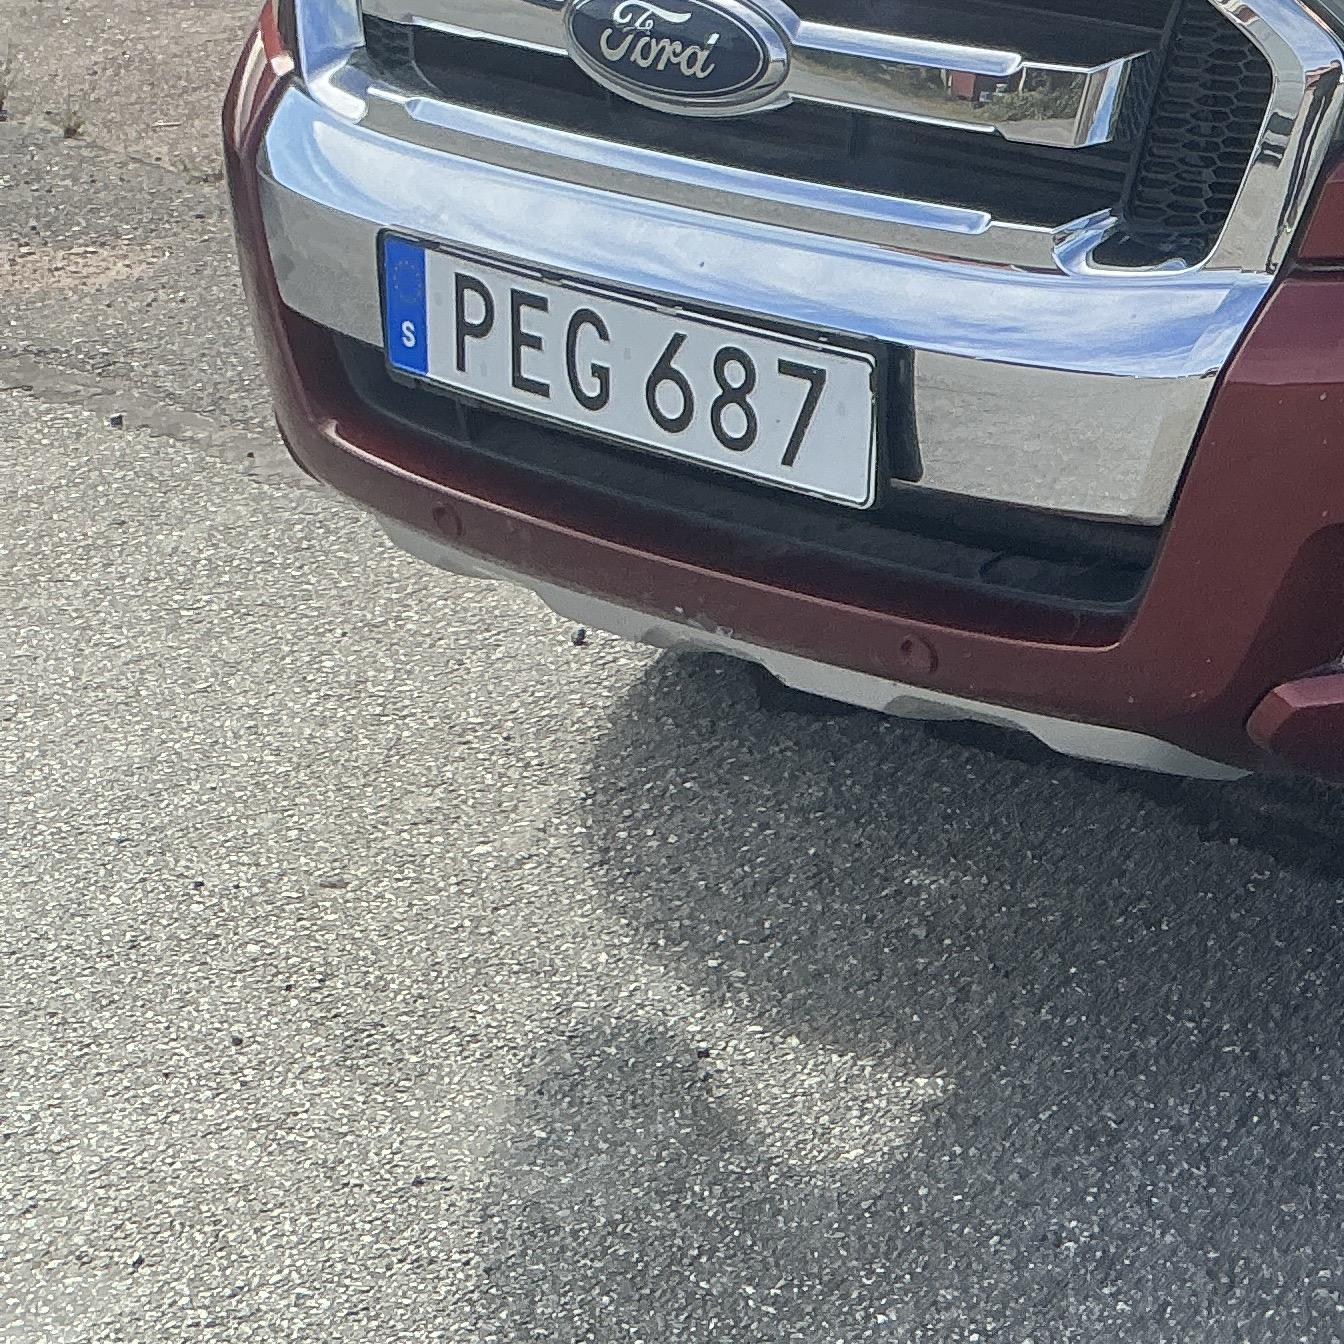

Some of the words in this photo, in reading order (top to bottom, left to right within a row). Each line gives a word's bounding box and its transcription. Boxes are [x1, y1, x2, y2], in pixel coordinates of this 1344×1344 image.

[401, 320, 416, 349] S
[453, 271, 612, 413] PEG
[645, 331, 828, 468] 687
